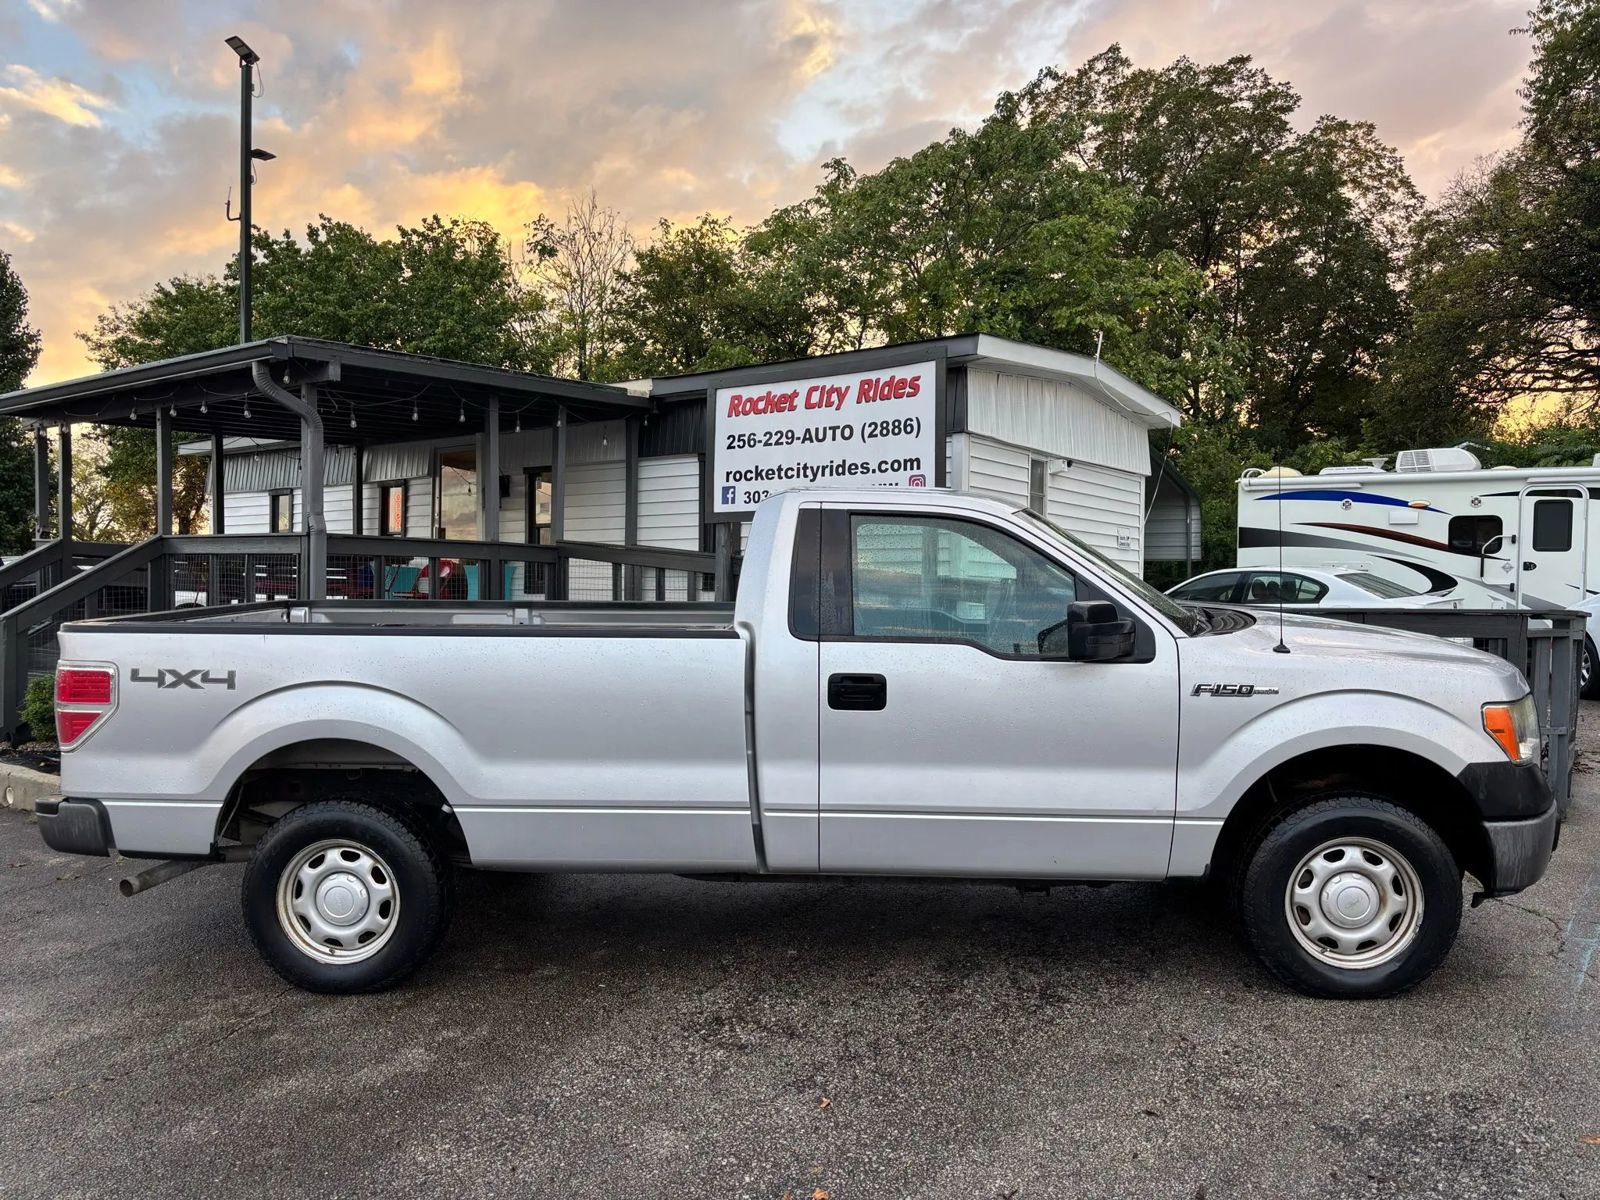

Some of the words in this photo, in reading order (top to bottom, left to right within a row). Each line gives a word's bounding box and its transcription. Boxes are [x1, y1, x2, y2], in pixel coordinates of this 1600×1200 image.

[727, 389, 799, 417] Rocket
[804, 384, 851, 411] City
[856, 375, 922, 404] Rides
[727, 424, 854, 450] 256-229-AUTO
[860, 417, 922, 443] (2886)
[725, 457, 922, 483] rocketcityrides.com
